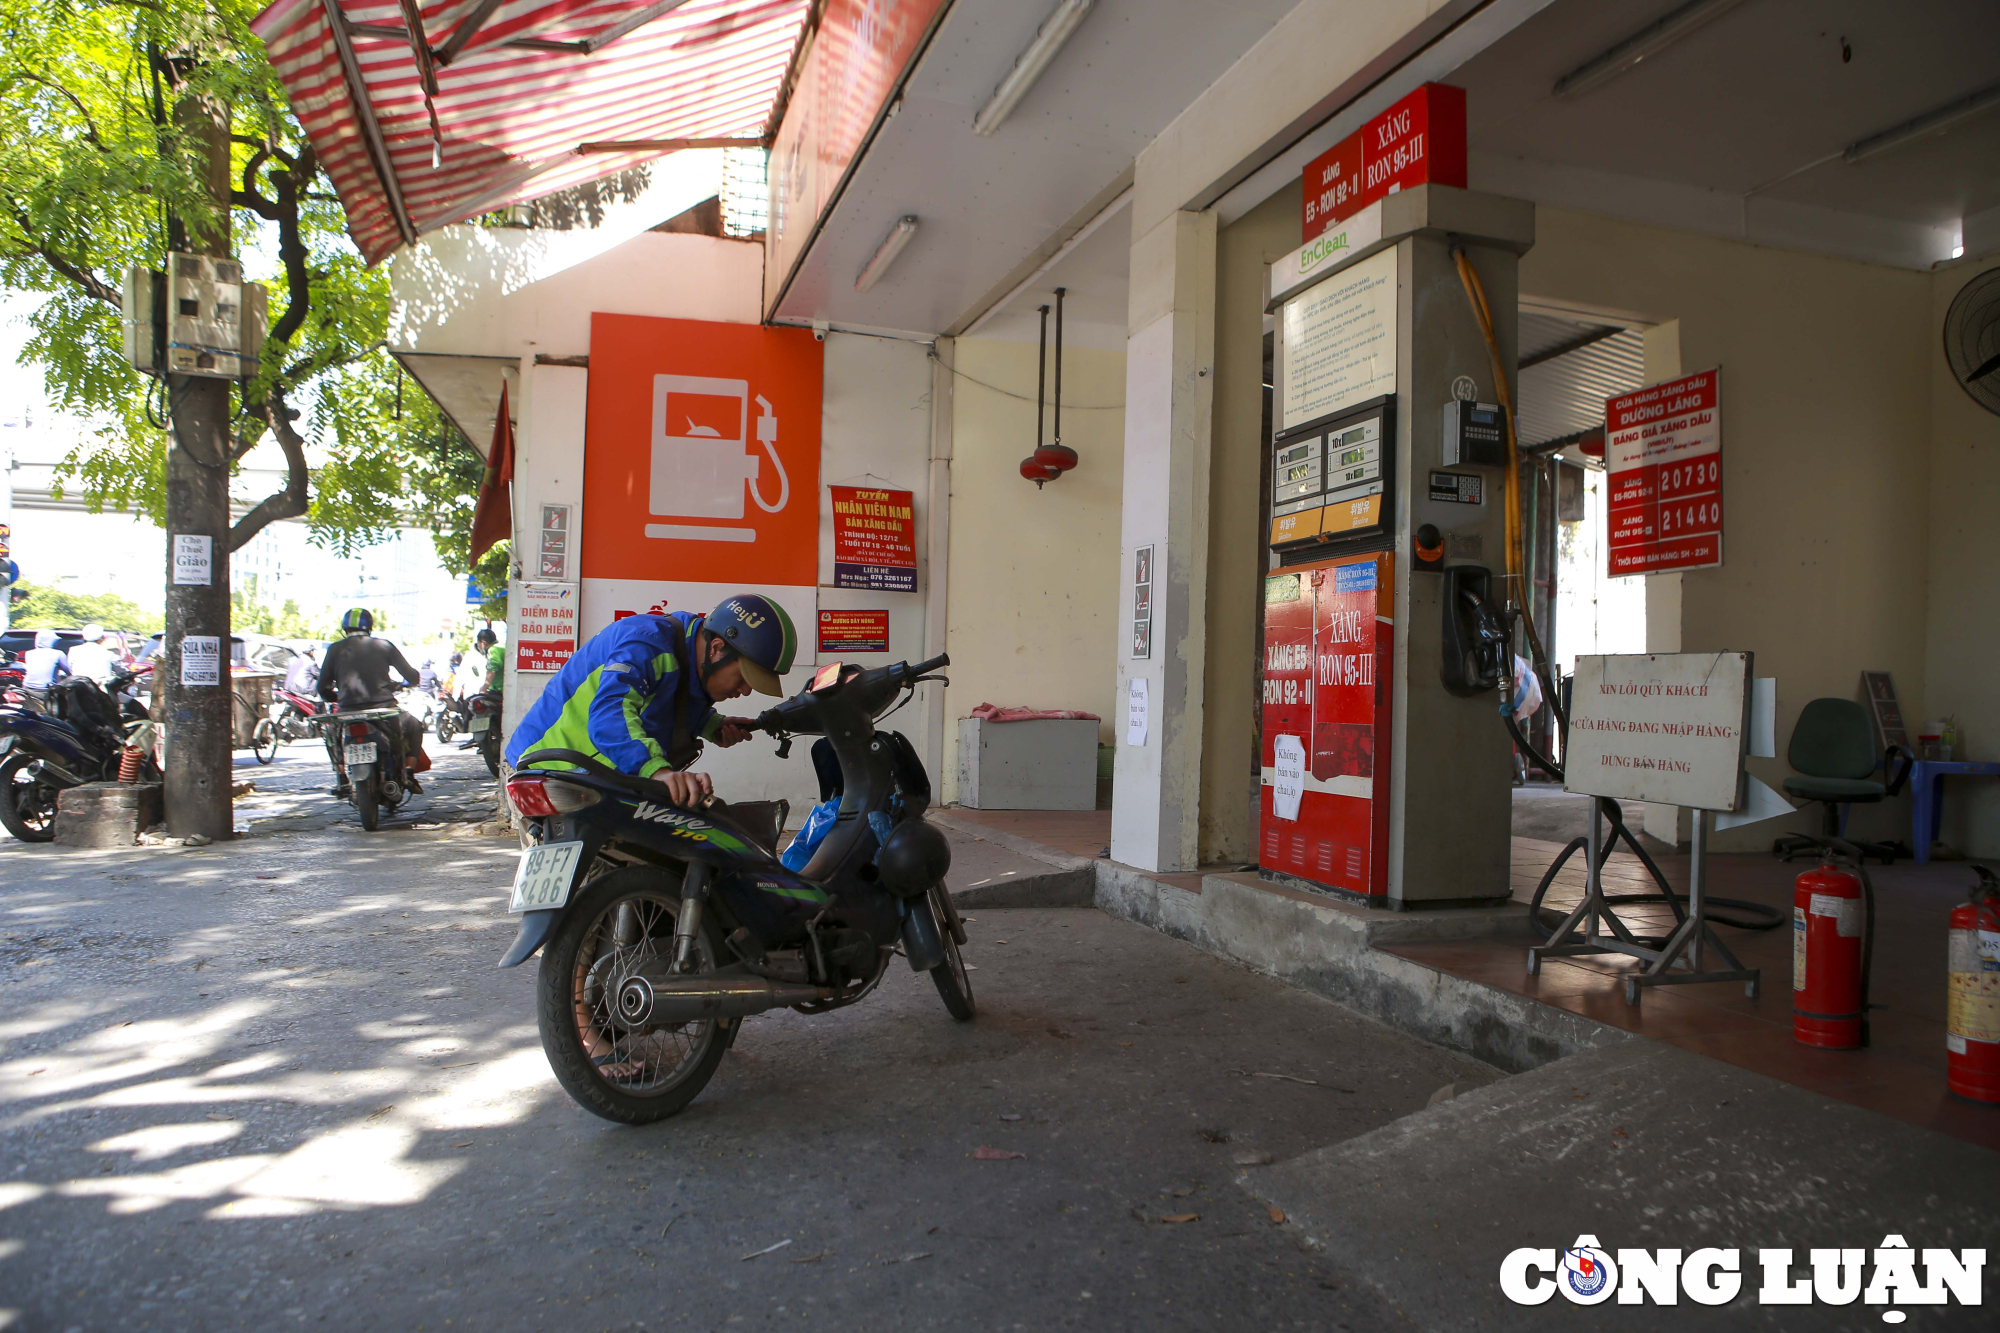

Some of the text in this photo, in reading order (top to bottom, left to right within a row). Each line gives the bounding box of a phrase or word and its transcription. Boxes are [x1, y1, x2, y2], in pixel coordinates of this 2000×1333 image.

[1378, 109, 1410, 150] XĂNG
[1367, 133, 1423, 189] RON 95-III
[1322, 161, 1340, 185] XĂNG
[1306, 173, 1358, 224] E5 RON 92 II
[1301, 231, 1347, 268] EnClean
[1457, 382, 1472, 400] 43
[1616, 378, 1707, 410] CỬA HÀNG XĂNG DẦU
[1620, 394, 1701, 425] ĐƯỜNG LÁNG
[1613, 413, 1712, 446] BẢNG GIÁ XĂNG DẦU
[1624, 478, 1642, 489] XĂNG
[856, 490, 889, 501] TUYỂN
[835, 500, 911, 519] NHÂN VIÊN NAM
[1350, 500, 1370, 515] 휘발유
[846, 517, 902, 532] BÁN XĂNG DẦU
[1280, 516, 1296, 530] 휘발유
[1352, 517, 1369, 527] gasoline
[1622, 515, 1643, 526] XĂNG
[182, 536, 202, 544] Cho
[844, 530, 865, 538] TRÌNH
[880, 534, 899, 542] 12/12
[1614, 529, 1631, 538] RON
[844, 539, 860, 547] TUỔI
[862, 540, 871, 548] TỪ
[896, 544, 911, 552] TUỔI
[1618, 557, 1631, 566] THỜI
[1695, 547, 1709, 556] 23H
[863, 566, 880, 574] LIÊN
[521, 604, 573, 618] ĐIỂM BÁN
[521, 621, 572, 634] BẢO HIỂM
[1330, 605, 1362, 643] XĂNG
[520, 647, 573, 658] Ôtô Xe máy
[1268, 641, 1307, 670] XĂNG E5
[531, 660, 561, 669] Tài sản
[1320, 654, 1372, 685] RON 95-III
[1131, 690, 1143, 700] Không
[1263, 679, 1311, 704] RON 92 II
[1619, 680, 1637, 695] LỖI
[1640, 682, 1663, 697] QUÝ
[1666, 682, 1708, 697] KHÁCH
[1575, 716, 1732, 738] CỬA HÀNG ĐANG NHẬP HÀNG
[1278, 748, 1297, 762] Không
[1278, 766, 1299, 779] bán vào
[1633, 756, 1655, 769] BÁN
[1658, 758, 1690, 773] HÀNG
[633, 801, 713, 830] Wave
[671, 829, 708, 841] 110
[526, 847, 572, 876] 89-F7
